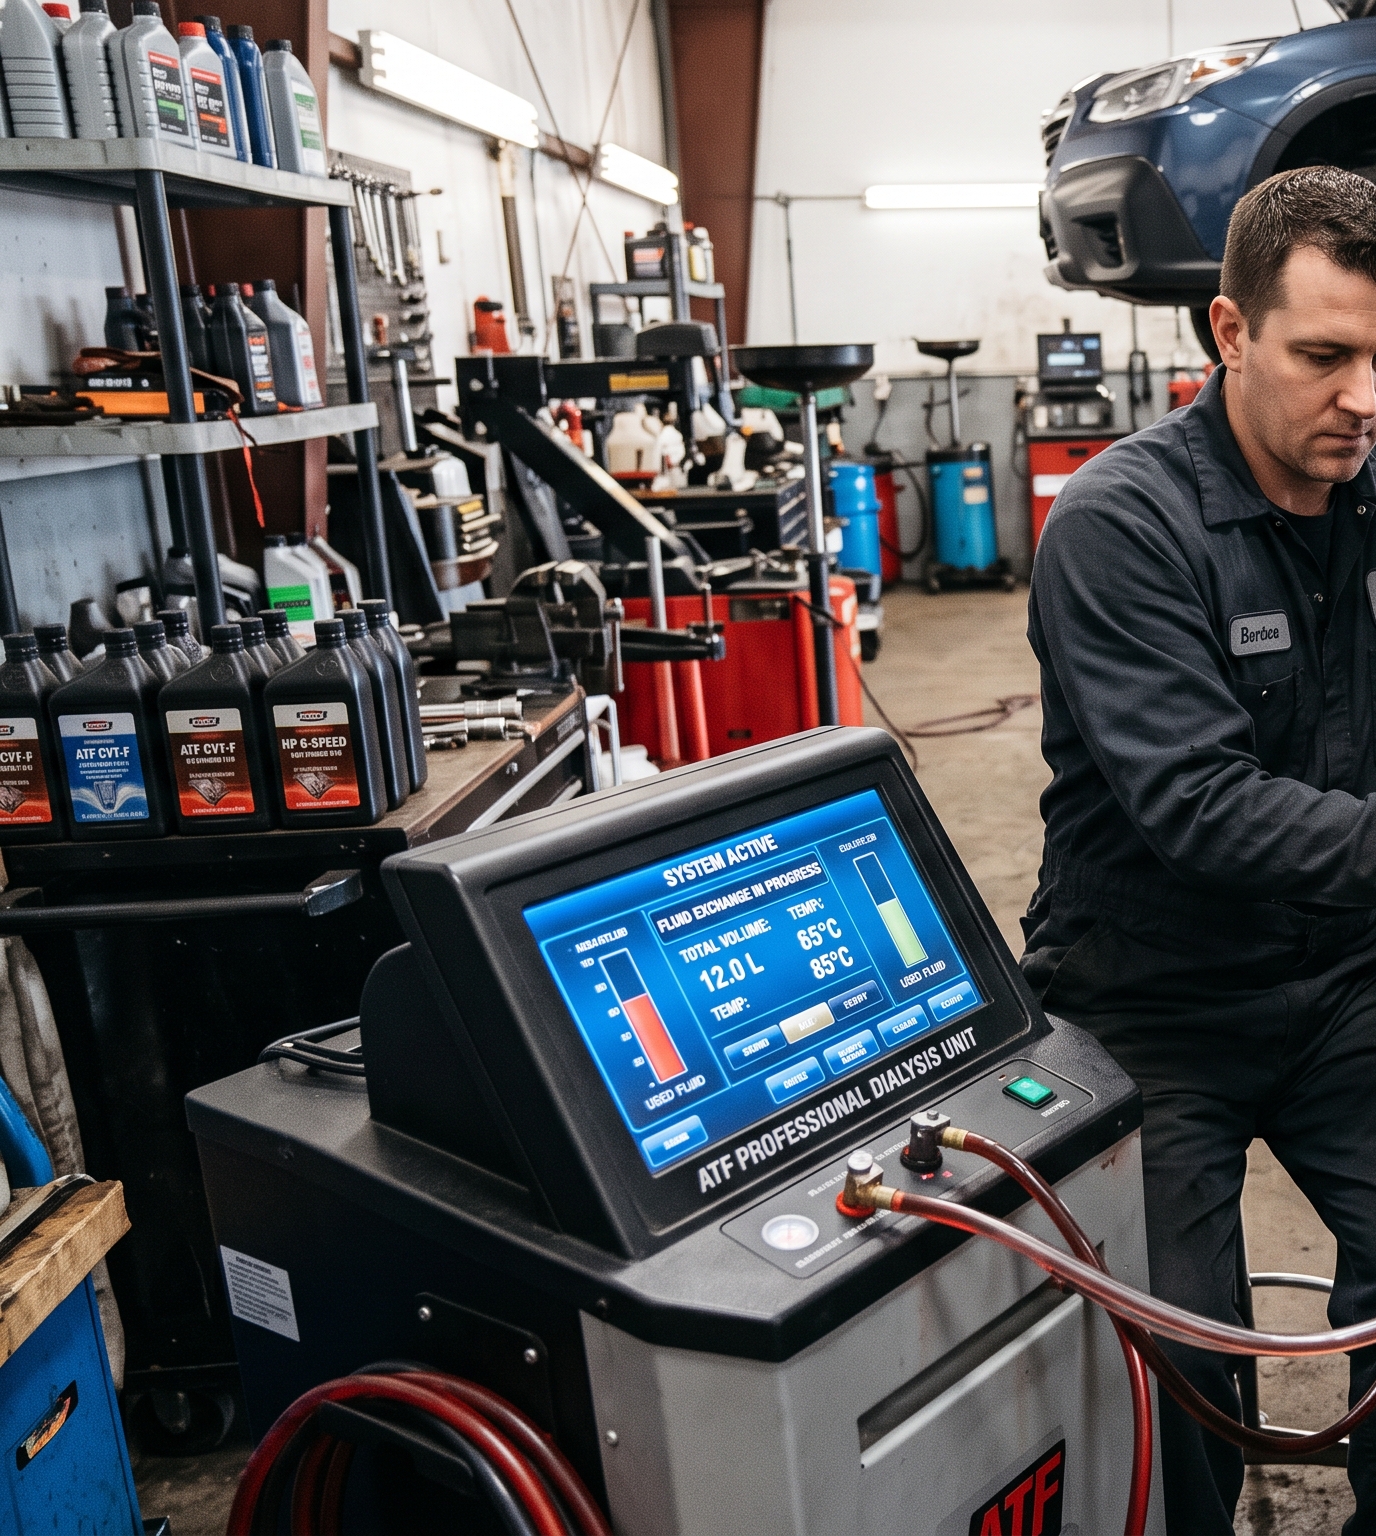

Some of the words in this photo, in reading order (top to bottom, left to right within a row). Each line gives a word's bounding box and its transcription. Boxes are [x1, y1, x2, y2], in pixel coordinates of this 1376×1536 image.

[75, 748, 96, 760] ATF
[97, 746, 130, 759] CVT-F
[180, 743, 200, 756] ATF
[203, 742, 236, 755] CVT-F
[281, 738, 298, 750] HP
[299, 736, 347, 749] 6-SPEED
[663, 852, 726, 887] SYSTEM
[726, 833, 778, 866] ACTIVE
[692, 887, 753, 920] EXCHANGE
[750, 882, 766, 898] IN
[764, 861, 822, 893] PROGRESS
[678, 938, 721, 964] TOTAL
[718, 917, 772, 948] VOLUME:
[700, 957, 746, 993] 12.0
[744, 952, 765, 975] L
[809, 946, 854, 980] 85°C
[710, 996, 751, 1022] TEMP:
[697, 1153, 734, 1193] ATF
[734, 1086, 871, 1171] PROFESSIONAL
[868, 1048, 942, 1100] DIALYSIS
[941, 1026, 978, 1060] UNIT
